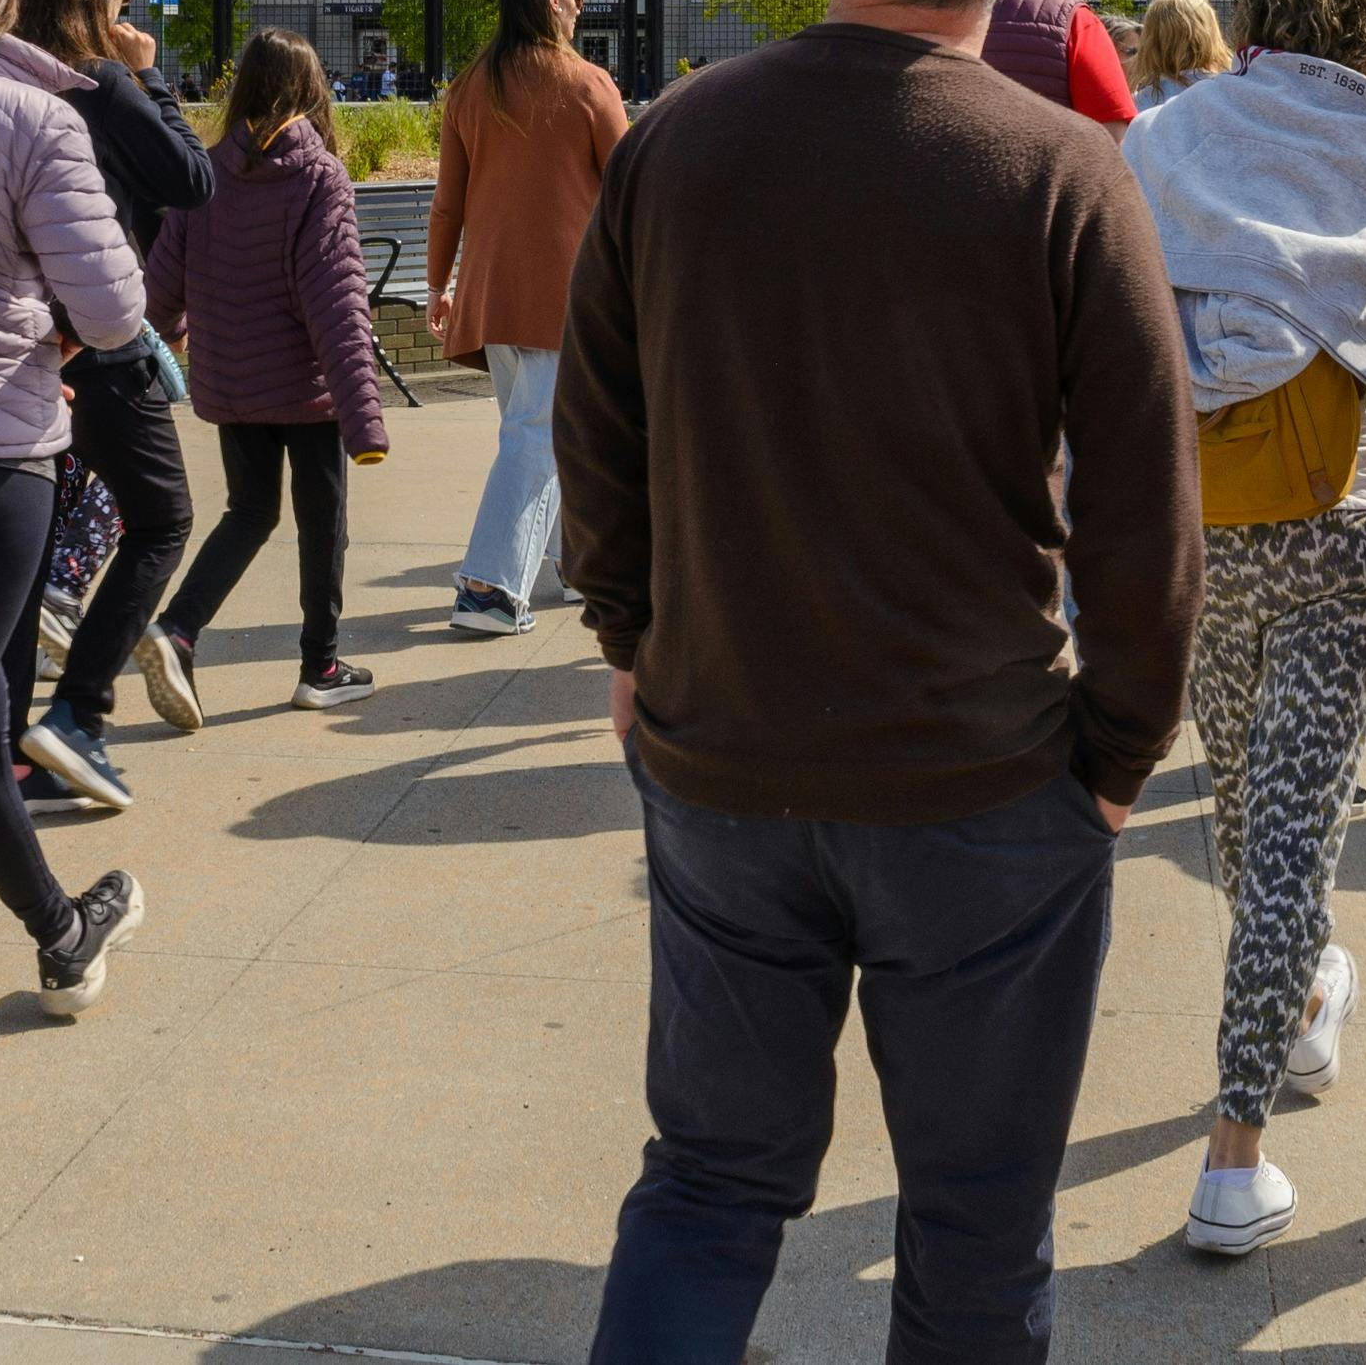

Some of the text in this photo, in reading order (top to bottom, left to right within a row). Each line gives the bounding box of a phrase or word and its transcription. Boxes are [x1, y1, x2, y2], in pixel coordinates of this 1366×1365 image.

[344, 4, 373, 13] TICKETS
[1299, 62, 1366, 96] EST. 1636
